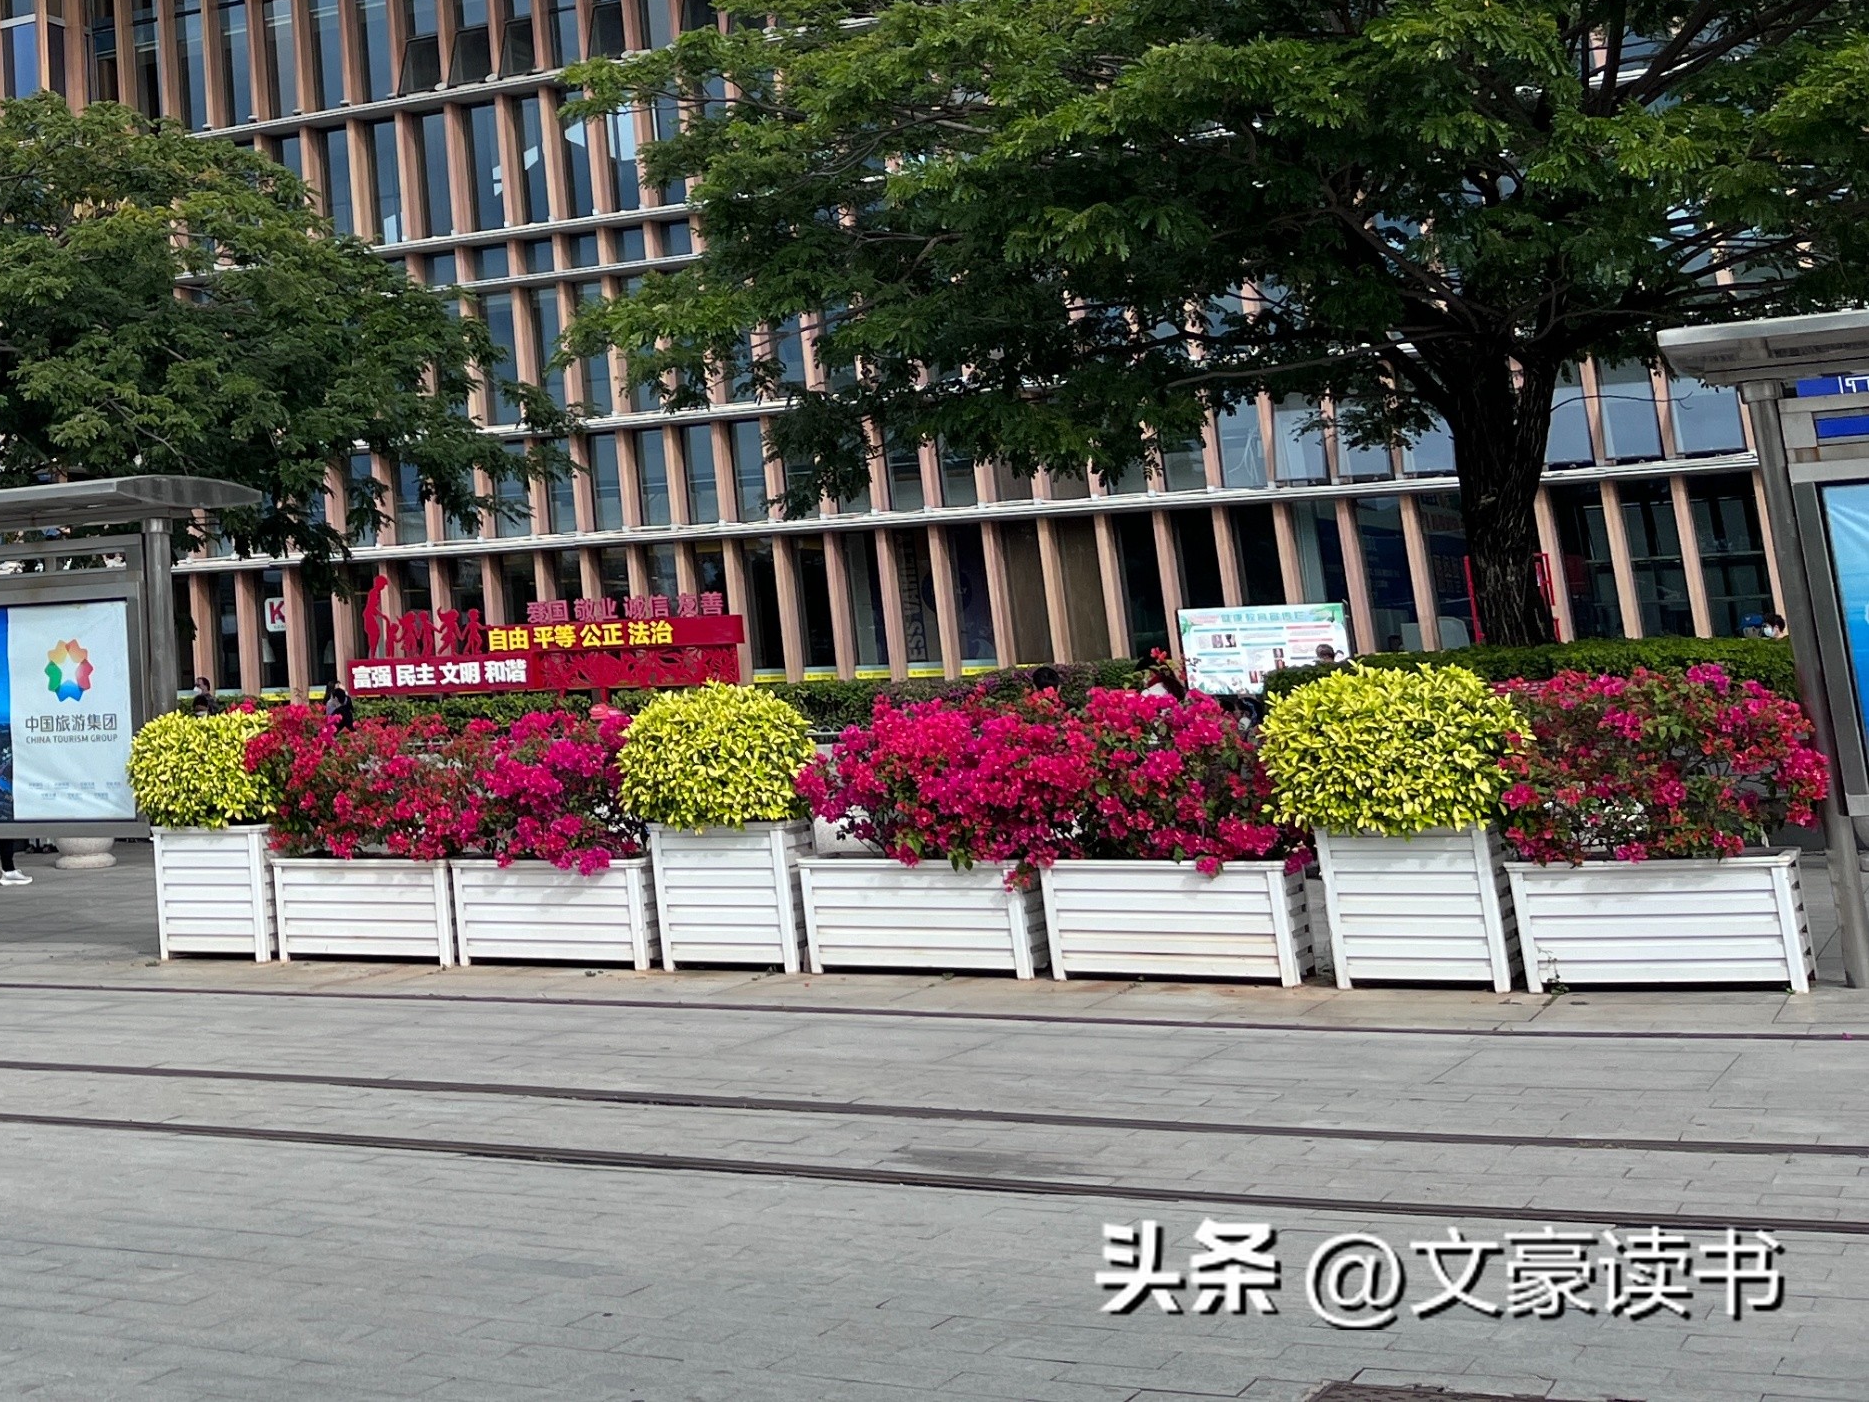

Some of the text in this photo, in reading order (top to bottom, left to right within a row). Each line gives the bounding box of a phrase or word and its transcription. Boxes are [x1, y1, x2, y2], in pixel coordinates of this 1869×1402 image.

[526, 591, 724, 624] 爱国 敬业 诚信 友善
[488, 620, 674, 652] 自由 平等 公正 法治
[352, 659, 527, 689] 富强 民主 文明 和谐
[25, 713, 117, 732] 中国旅游集团
[26, 734, 118, 744] CHINA TOURISM GROUP
